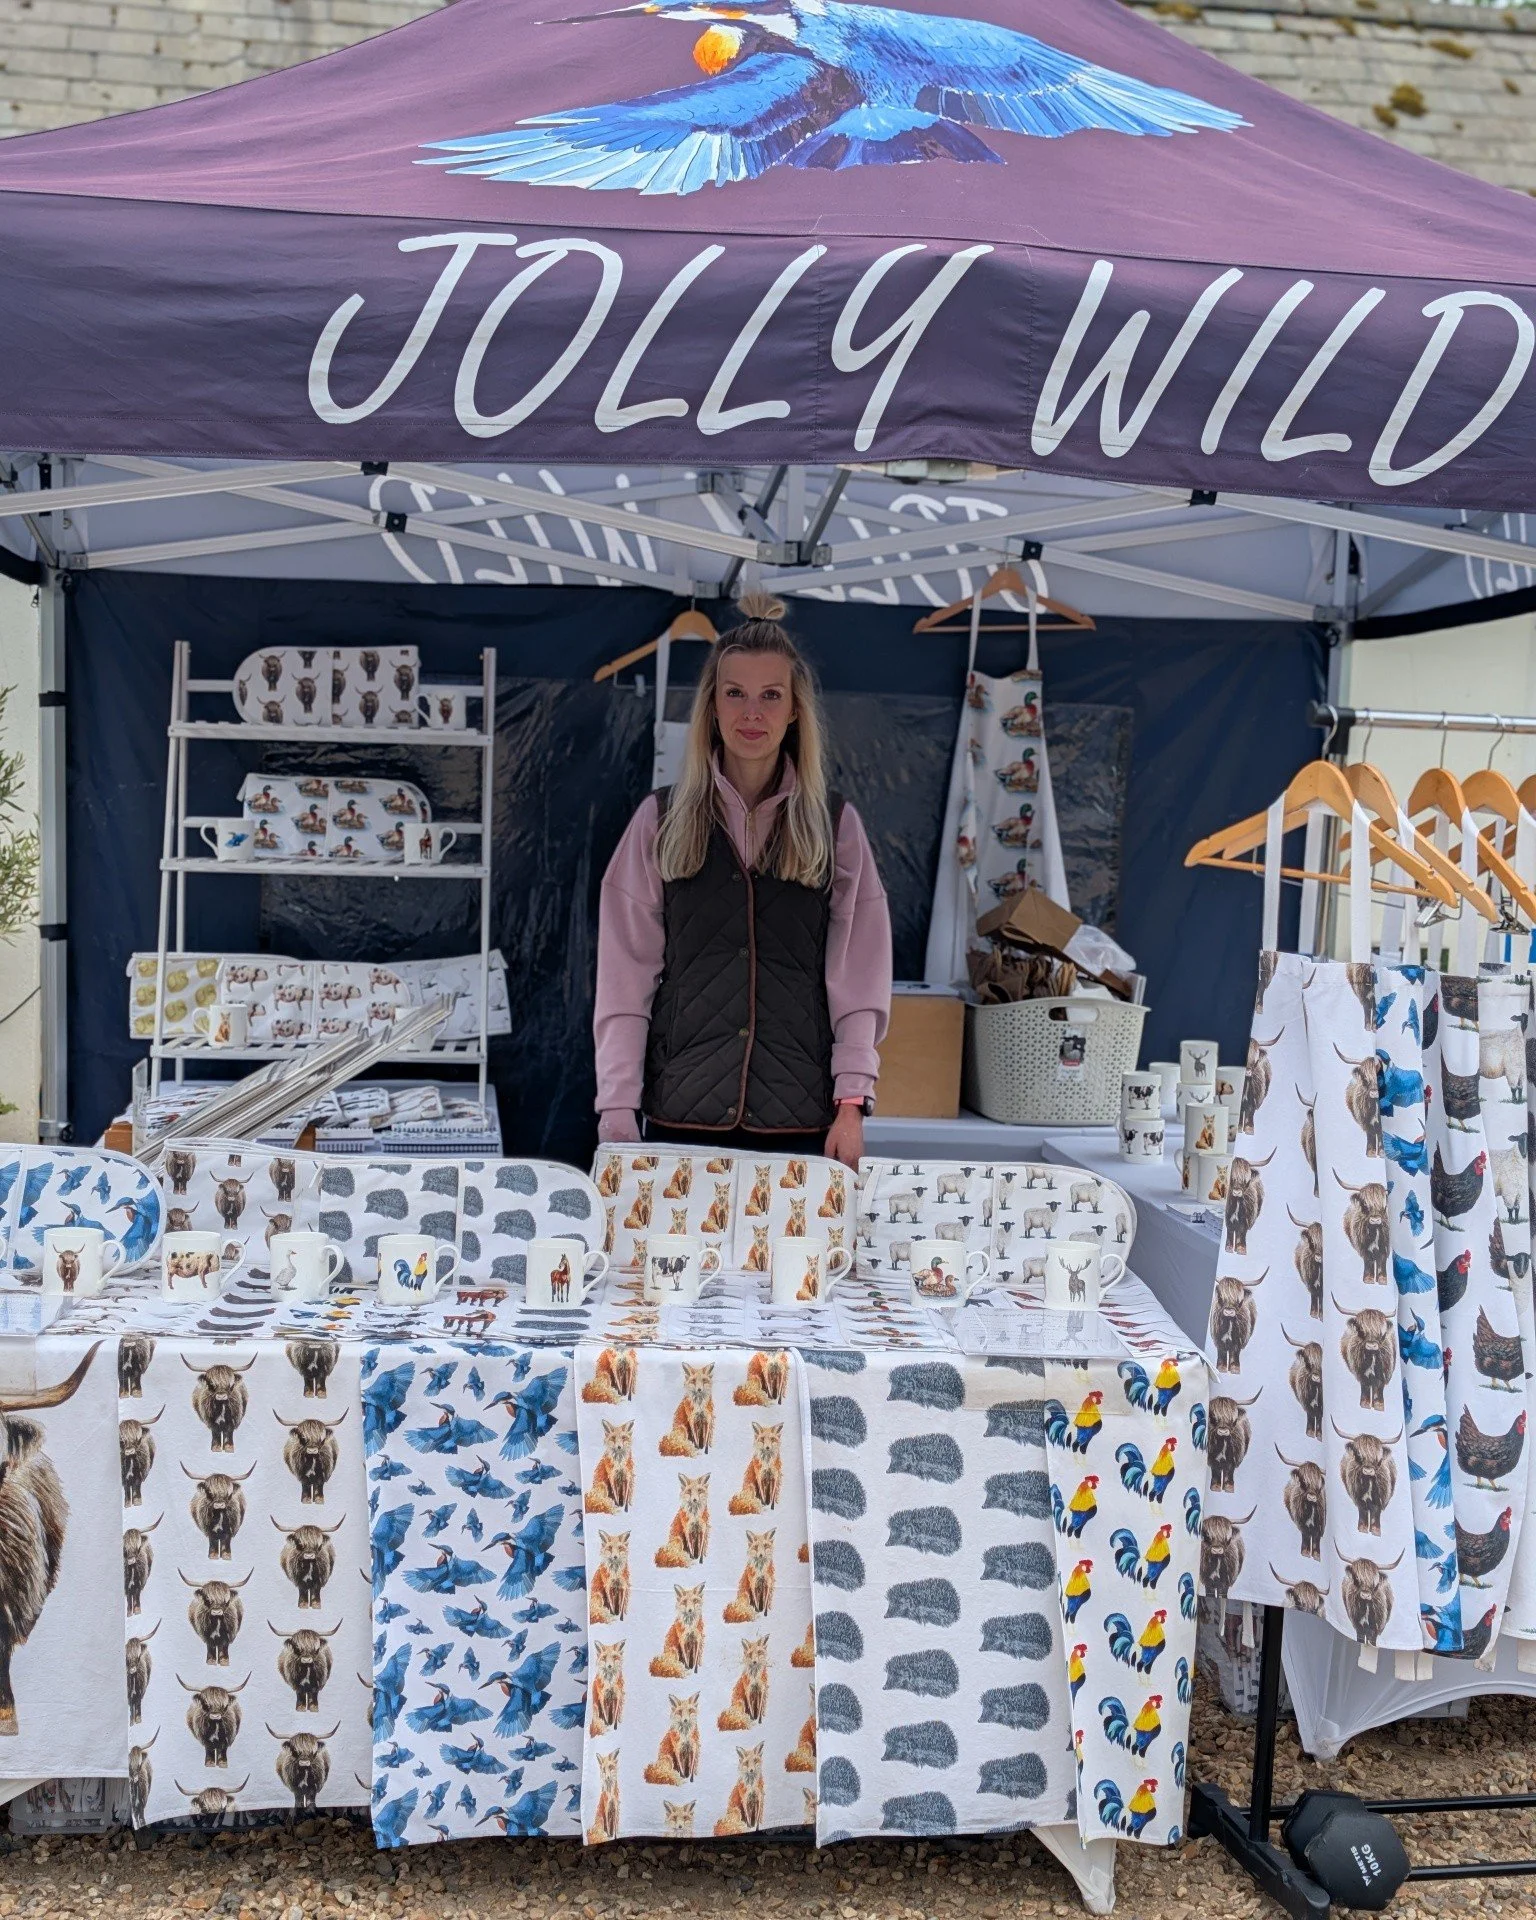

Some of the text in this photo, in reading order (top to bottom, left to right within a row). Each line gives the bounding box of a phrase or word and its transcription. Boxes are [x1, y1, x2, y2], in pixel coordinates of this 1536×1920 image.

[309, 232, 1536, 486] JOLLY WILD
[1350, 1845, 1368, 1874] METIS
[1361, 1844, 1382, 1876] 10KG
